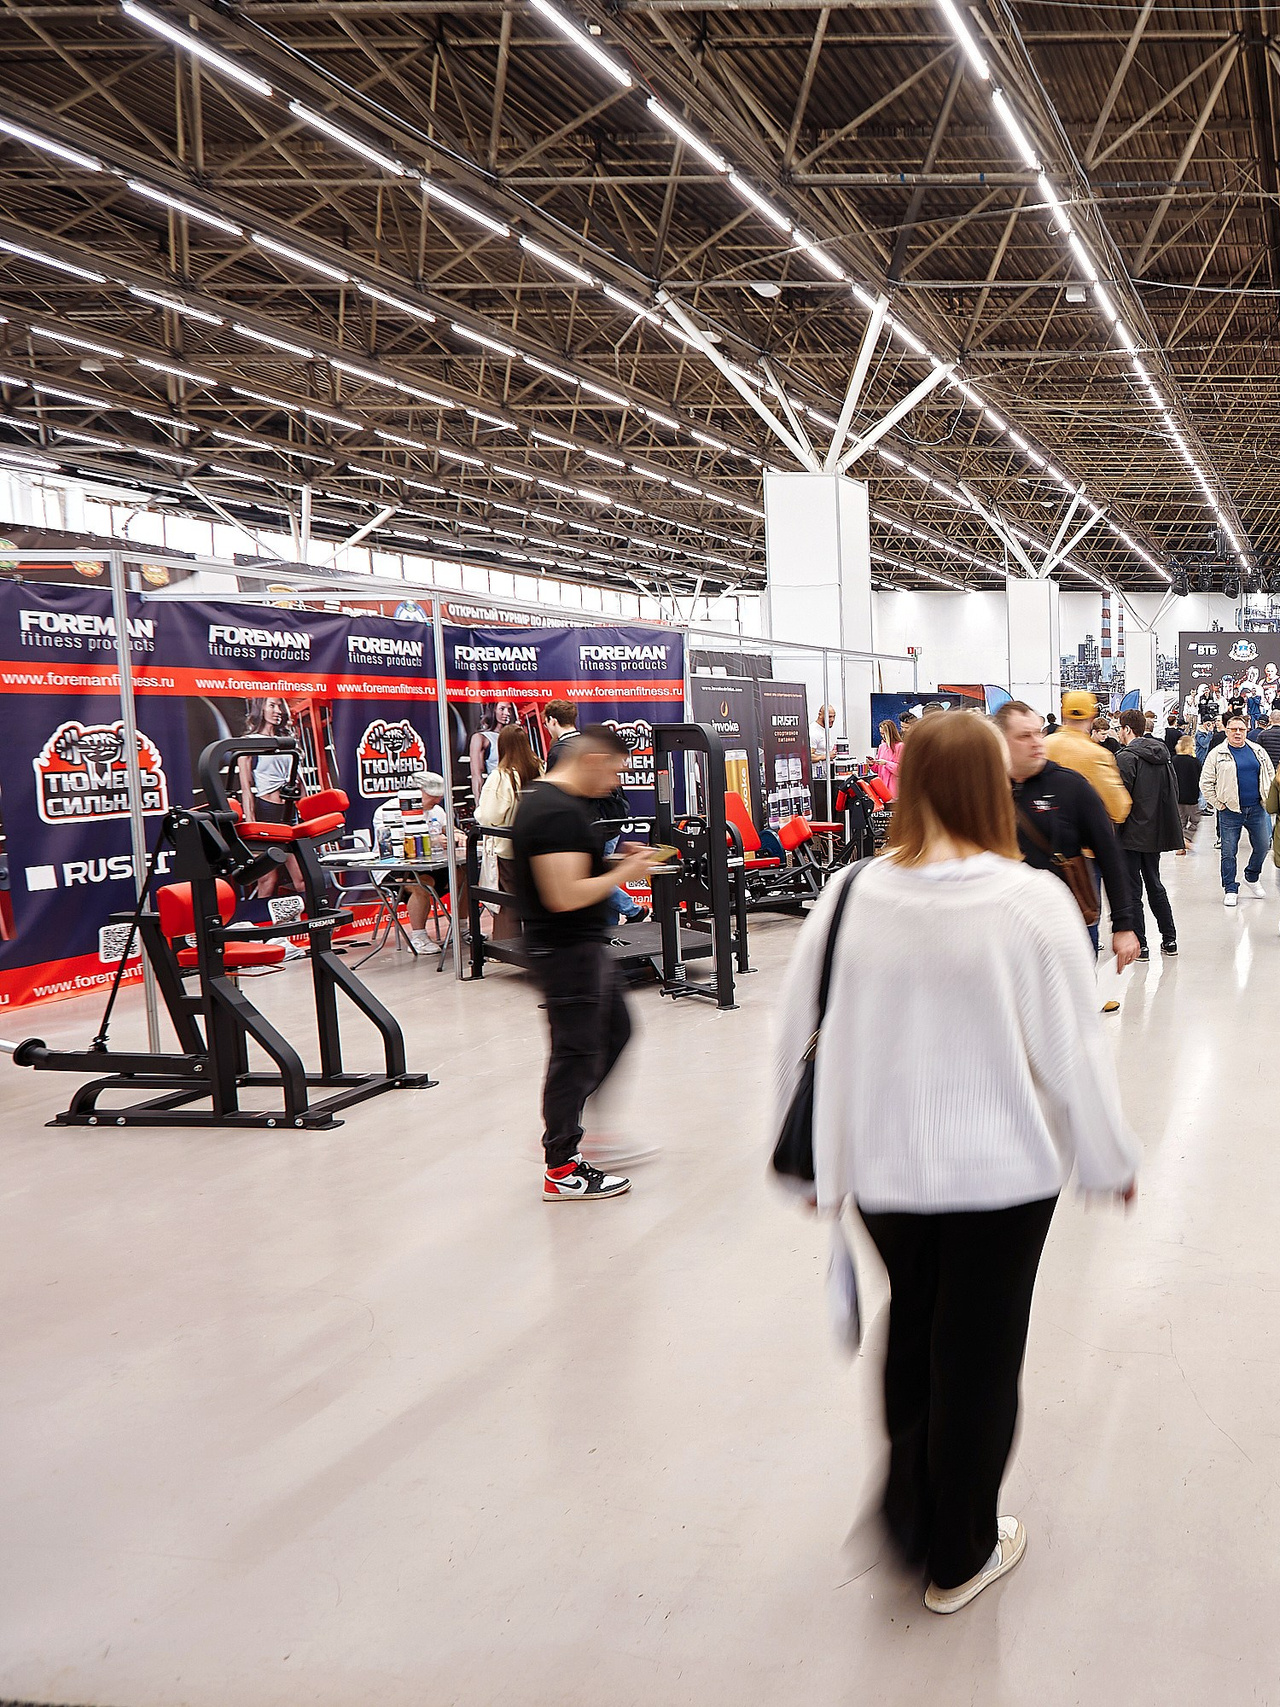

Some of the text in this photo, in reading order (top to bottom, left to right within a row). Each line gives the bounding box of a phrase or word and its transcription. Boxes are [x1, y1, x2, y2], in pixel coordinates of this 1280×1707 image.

[448, 603, 498, 622] ОТКРЫТЫЙ
[499, 610, 530, 625] ТУРНИР
[20, 631, 82, 649] fitness
[208, 624, 311, 650] FOREMAN
[208, 643, 311, 661] fitness products
[347, 635, 423, 657] FOREMAN
[454, 645, 536, 661] FOREMAN
[579, 645, 666, 660] FOREMAN
[1197, 644, 1218, 656] ВТБ
[348, 651, 423, 668] fitness products
[454, 660, 538, 673] fitness products
[579, 660, 668, 672] fitness products
[1, 672, 175, 688] www.foremanfiness.ru
[195, 677, 327, 692] www.foremanfitness.ru
[336, 682, 436, 695] www.foremanfitness.ru
[445, 686, 553, 698] www.foremanfitness.ru
[566, 686, 683, 697] www.foremanfitness.ru
[711, 719, 740, 732] invoke
[361, 757, 424, 775] ТЮМЕНЬ
[363, 775, 420, 793] СИЛЬНА
[46, 791, 160, 816] СИЛЬНЯ
[308, 918, 336, 929] FOREMAN
[33, 963, 144, 998] www.foremanf
